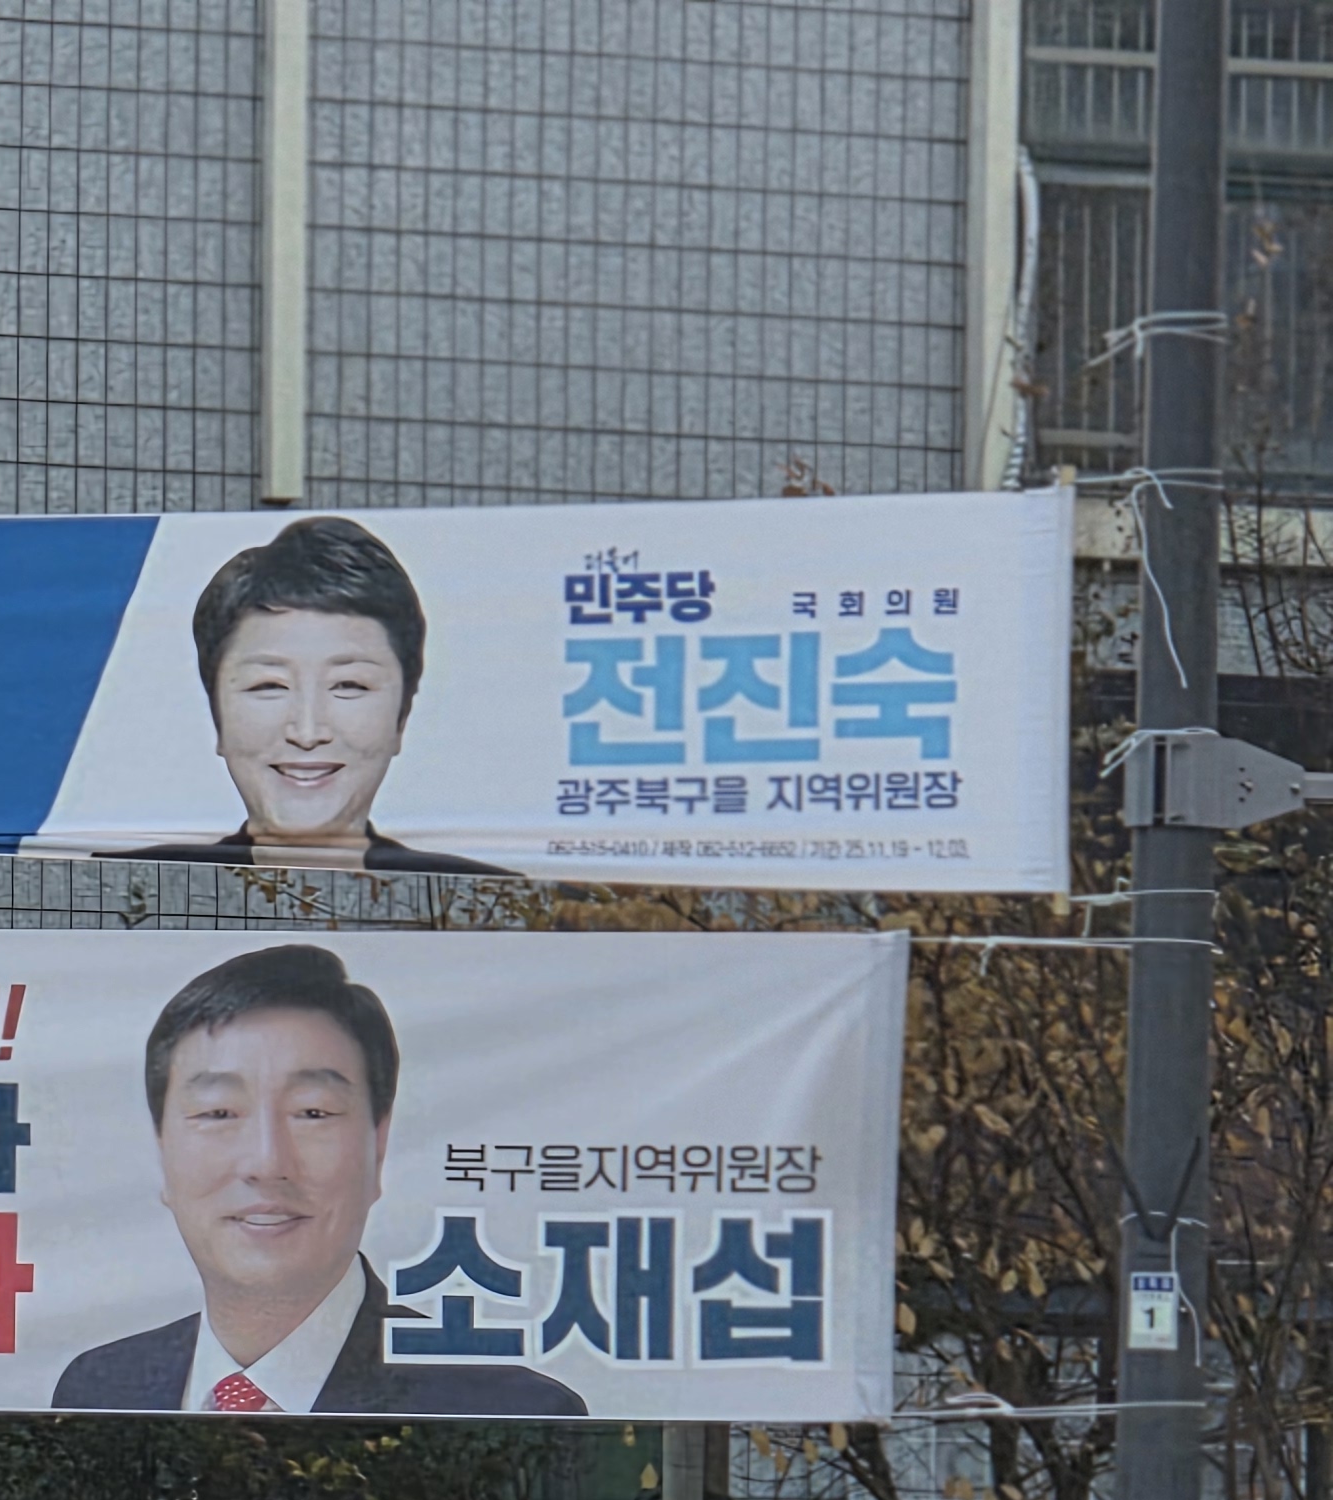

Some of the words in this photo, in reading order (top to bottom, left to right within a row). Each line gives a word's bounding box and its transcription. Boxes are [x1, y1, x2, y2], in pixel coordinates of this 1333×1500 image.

[564, 570, 715, 624] 민주당
[563, 628, 957, 766] 전진숙
[557, 776, 748, 816] 광주북구을
[766, 771, 962, 813] 지역위원장
[444, 1144, 823, 1194] 북구을지역위원장
[390, 1215, 825, 1362] 소재섭
